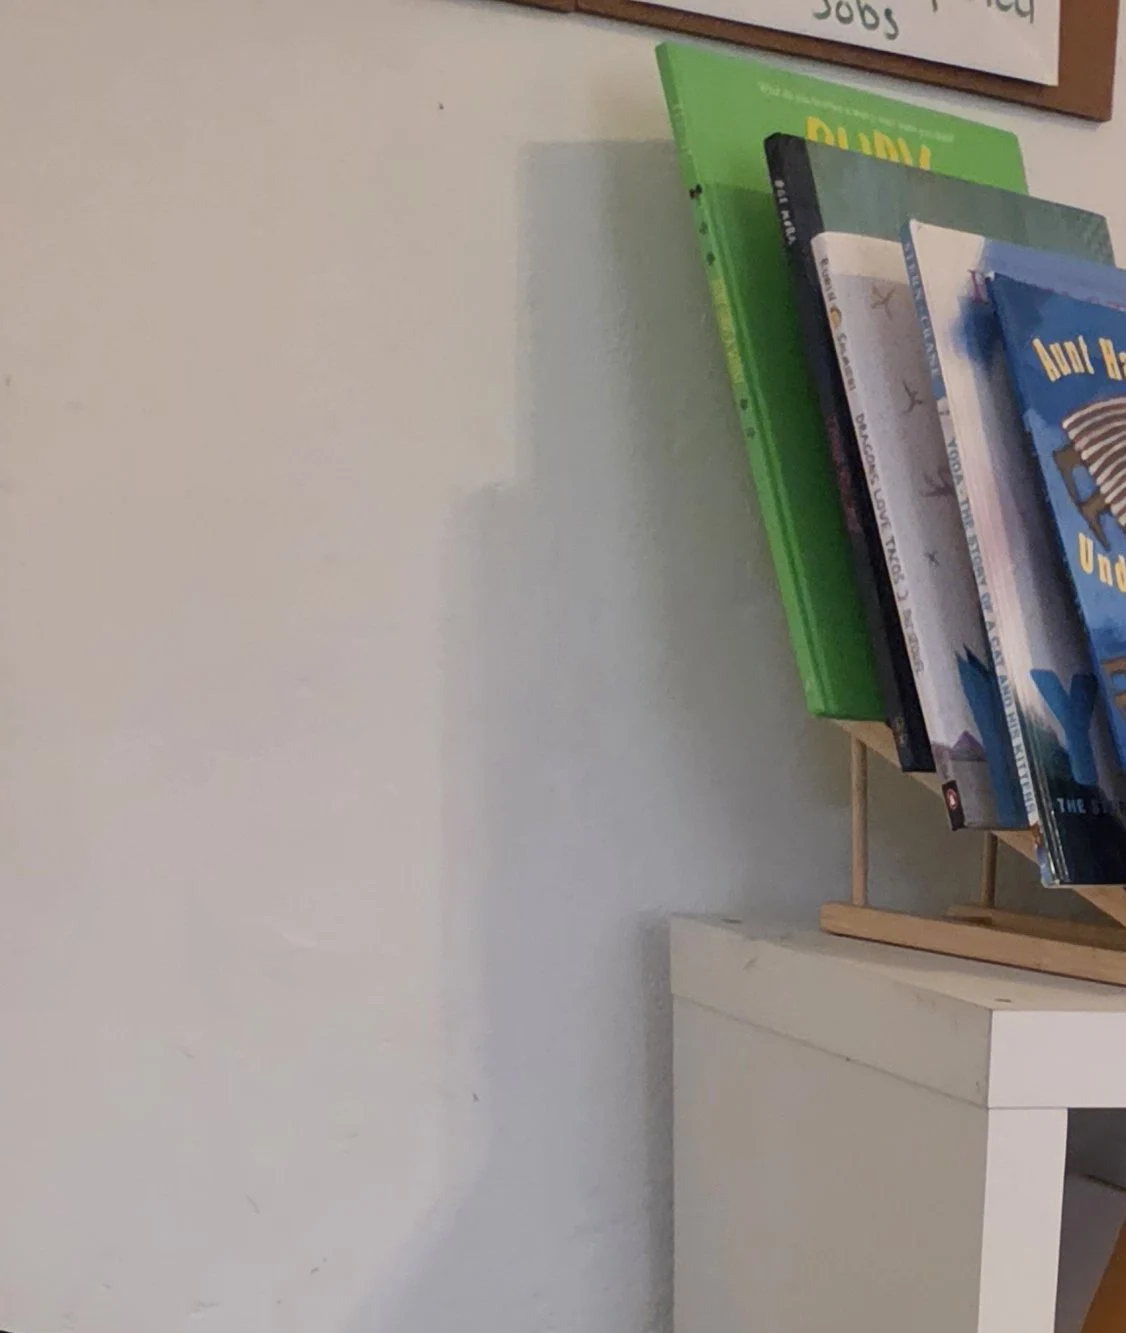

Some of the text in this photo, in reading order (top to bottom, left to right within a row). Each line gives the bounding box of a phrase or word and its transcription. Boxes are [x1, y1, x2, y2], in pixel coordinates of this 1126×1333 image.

[1032, 335, 1094, 382] Aunt
[853, 413, 881, 484] DRAGONS
[871, 488, 891, 530] LOVE
[882, 535, 905, 584] TACOS
[945, 437, 1038, 814] YODA THE STORY OF A CAT AND HIS KITTENS
